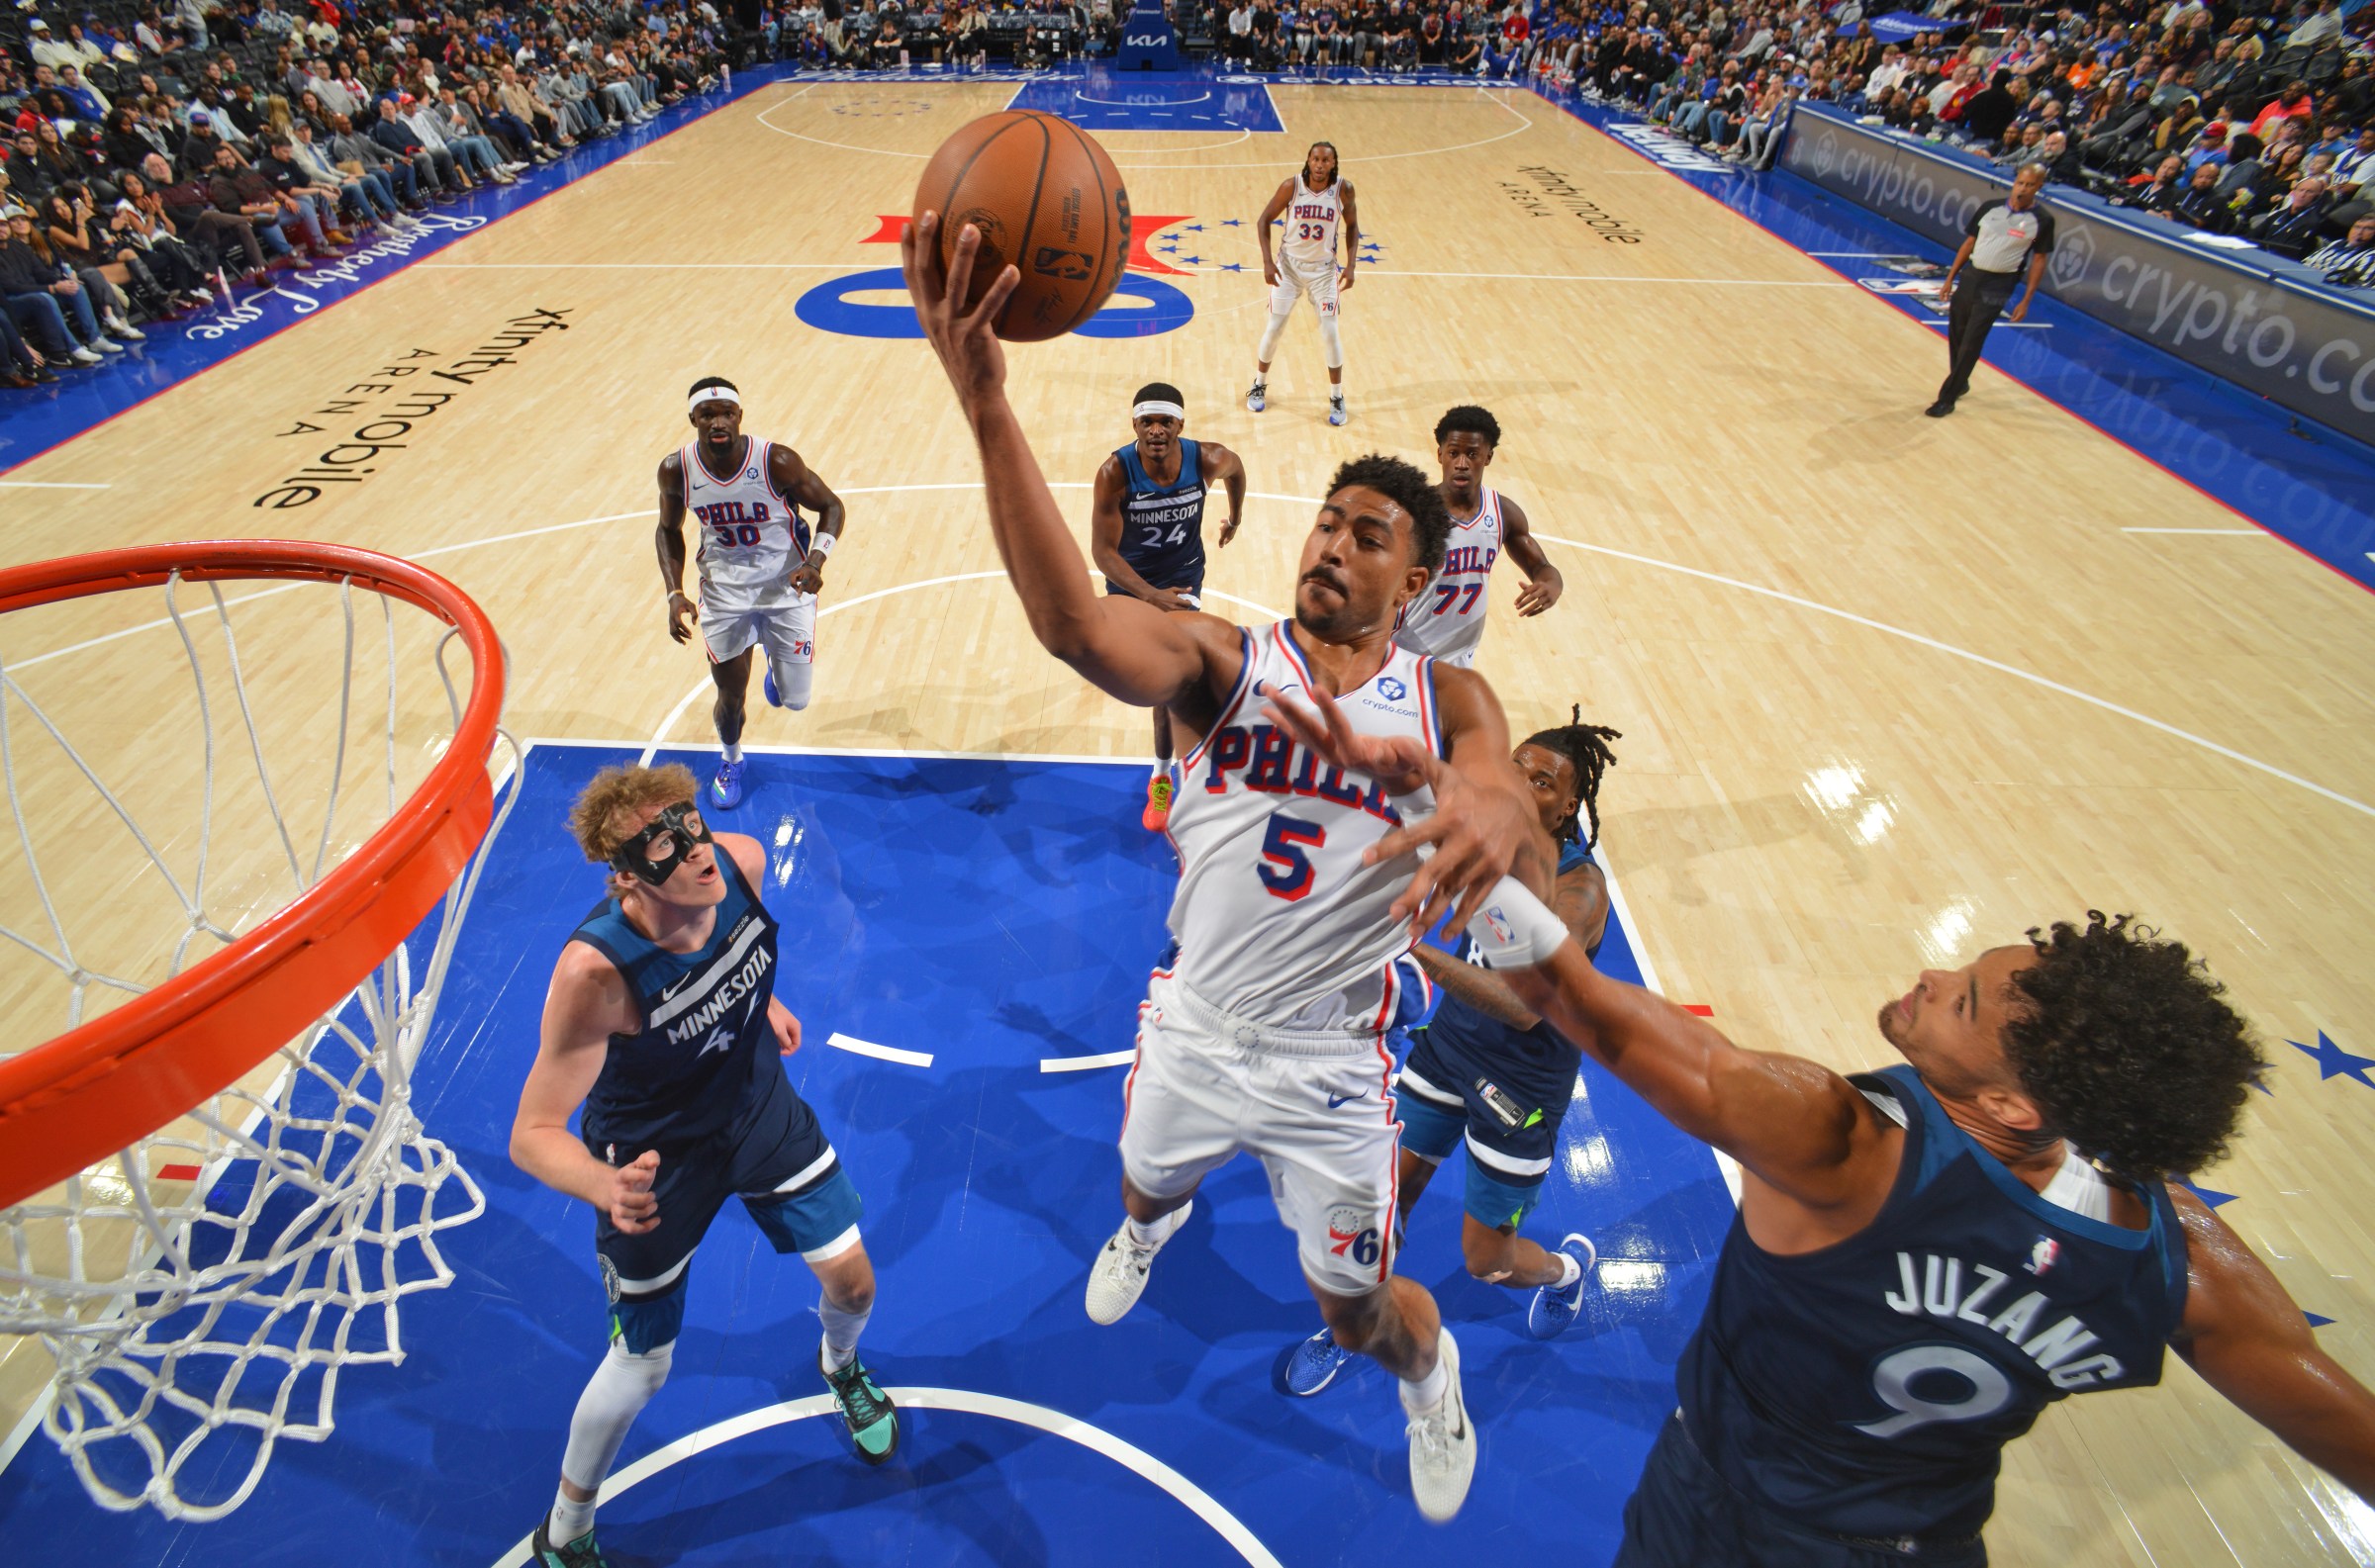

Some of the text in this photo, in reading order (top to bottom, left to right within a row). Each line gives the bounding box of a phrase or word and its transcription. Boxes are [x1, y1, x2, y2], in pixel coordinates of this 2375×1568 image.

[1126, 35, 1168, 46] KIA
[1280, 76, 1518, 88] crypto.com
[1494, 181, 1555, 218] ARENA
[1293, 205, 1335, 223] PHILA
[1561, 200, 1645, 244] mobile
[1298, 224, 1325, 241] 33
[186, 213, 488, 340] Brotherly Love
[1322, 302, 1334, 312] 76
[275, 348, 441, 437] ARENA
[252, 308, 575, 509] xfinity mobile
[694, 501, 771, 526] PHILA
[1130, 503, 1198, 524] MINNESOTA
[714, 524, 762, 548] 30
[1140, 523, 1187, 548] 24
[1436, 545, 1497, 576] HILA
[1433, 583, 1482, 615] 77
[794, 639, 811, 656] 76
[1363, 697, 1419, 719] crypto.com
[1256, 811, 1327, 902] 5
[731, 915, 749, 939] sezzle
[666, 945, 773, 1046] MINNESOTA
[1329, 1223, 1379, 1265] 76
[1884, 1251, 2128, 1391] JUZANG
[1849, 1342, 2014, 1440] 9
